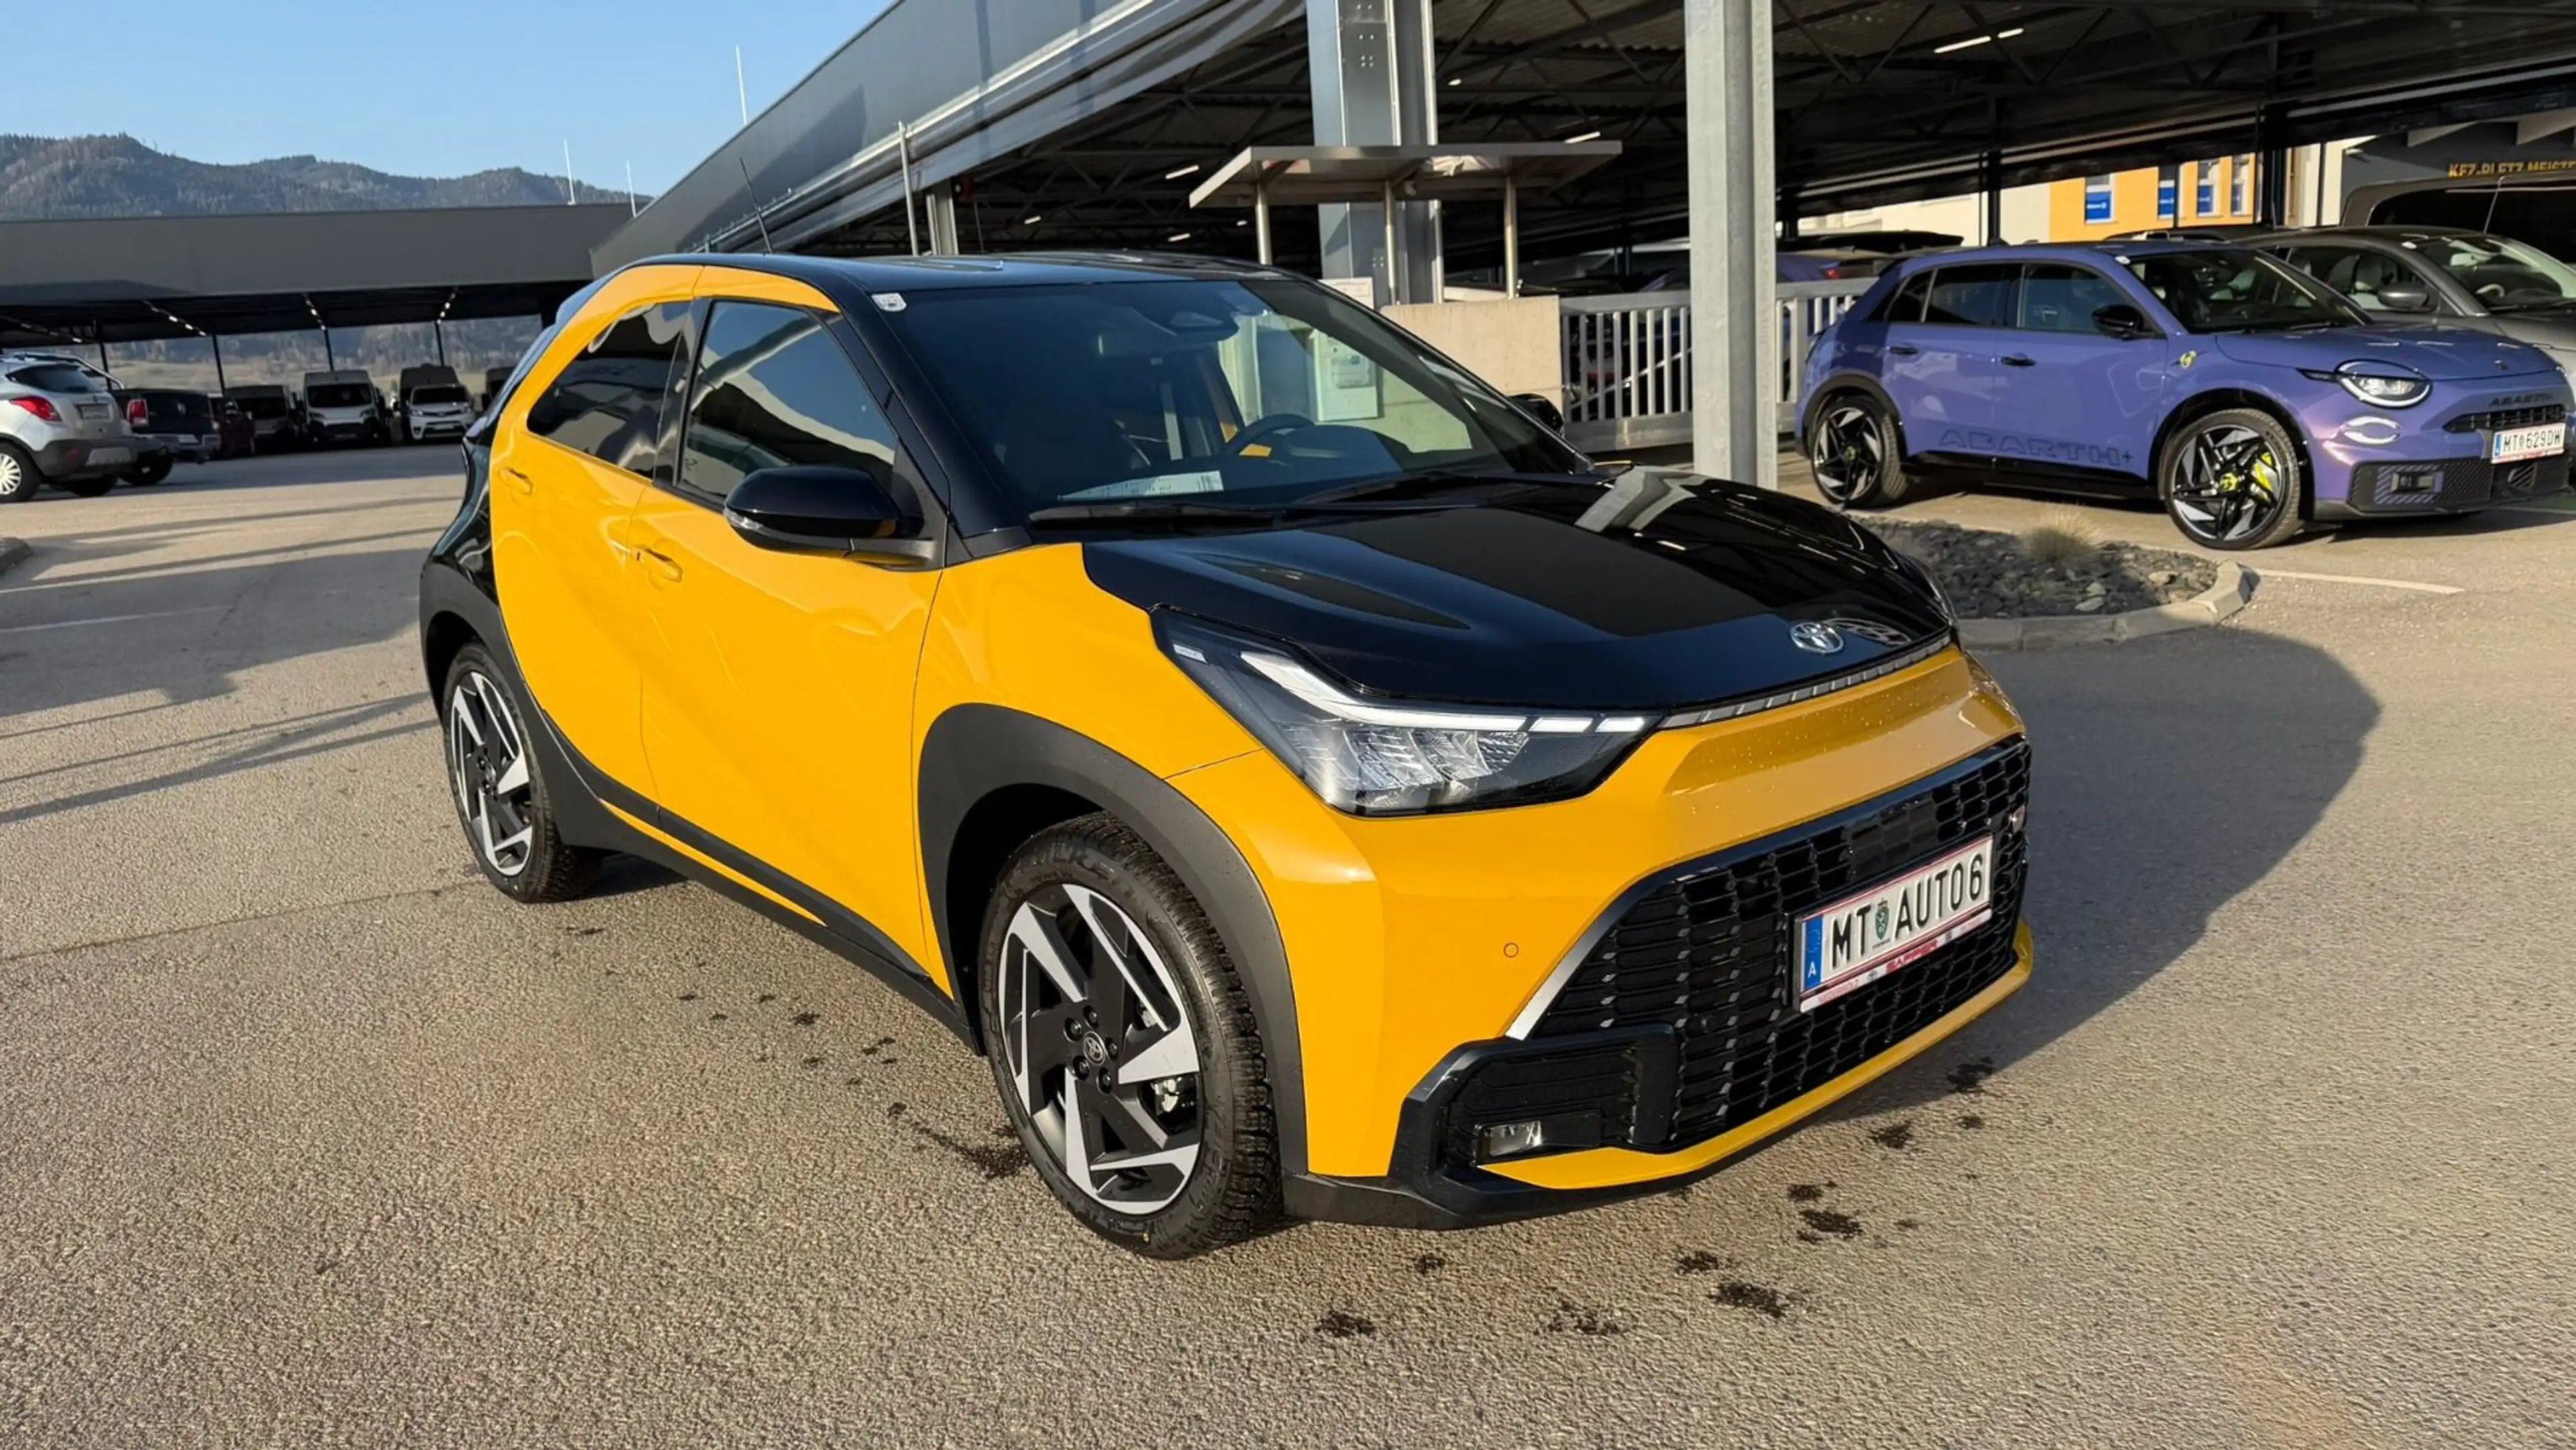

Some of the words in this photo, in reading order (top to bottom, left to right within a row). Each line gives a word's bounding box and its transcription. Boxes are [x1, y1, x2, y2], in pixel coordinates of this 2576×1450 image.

[2504, 434, 2518, 452] MT
[1808, 962, 1817, 978] A
[1832, 902, 1872, 970] MT
